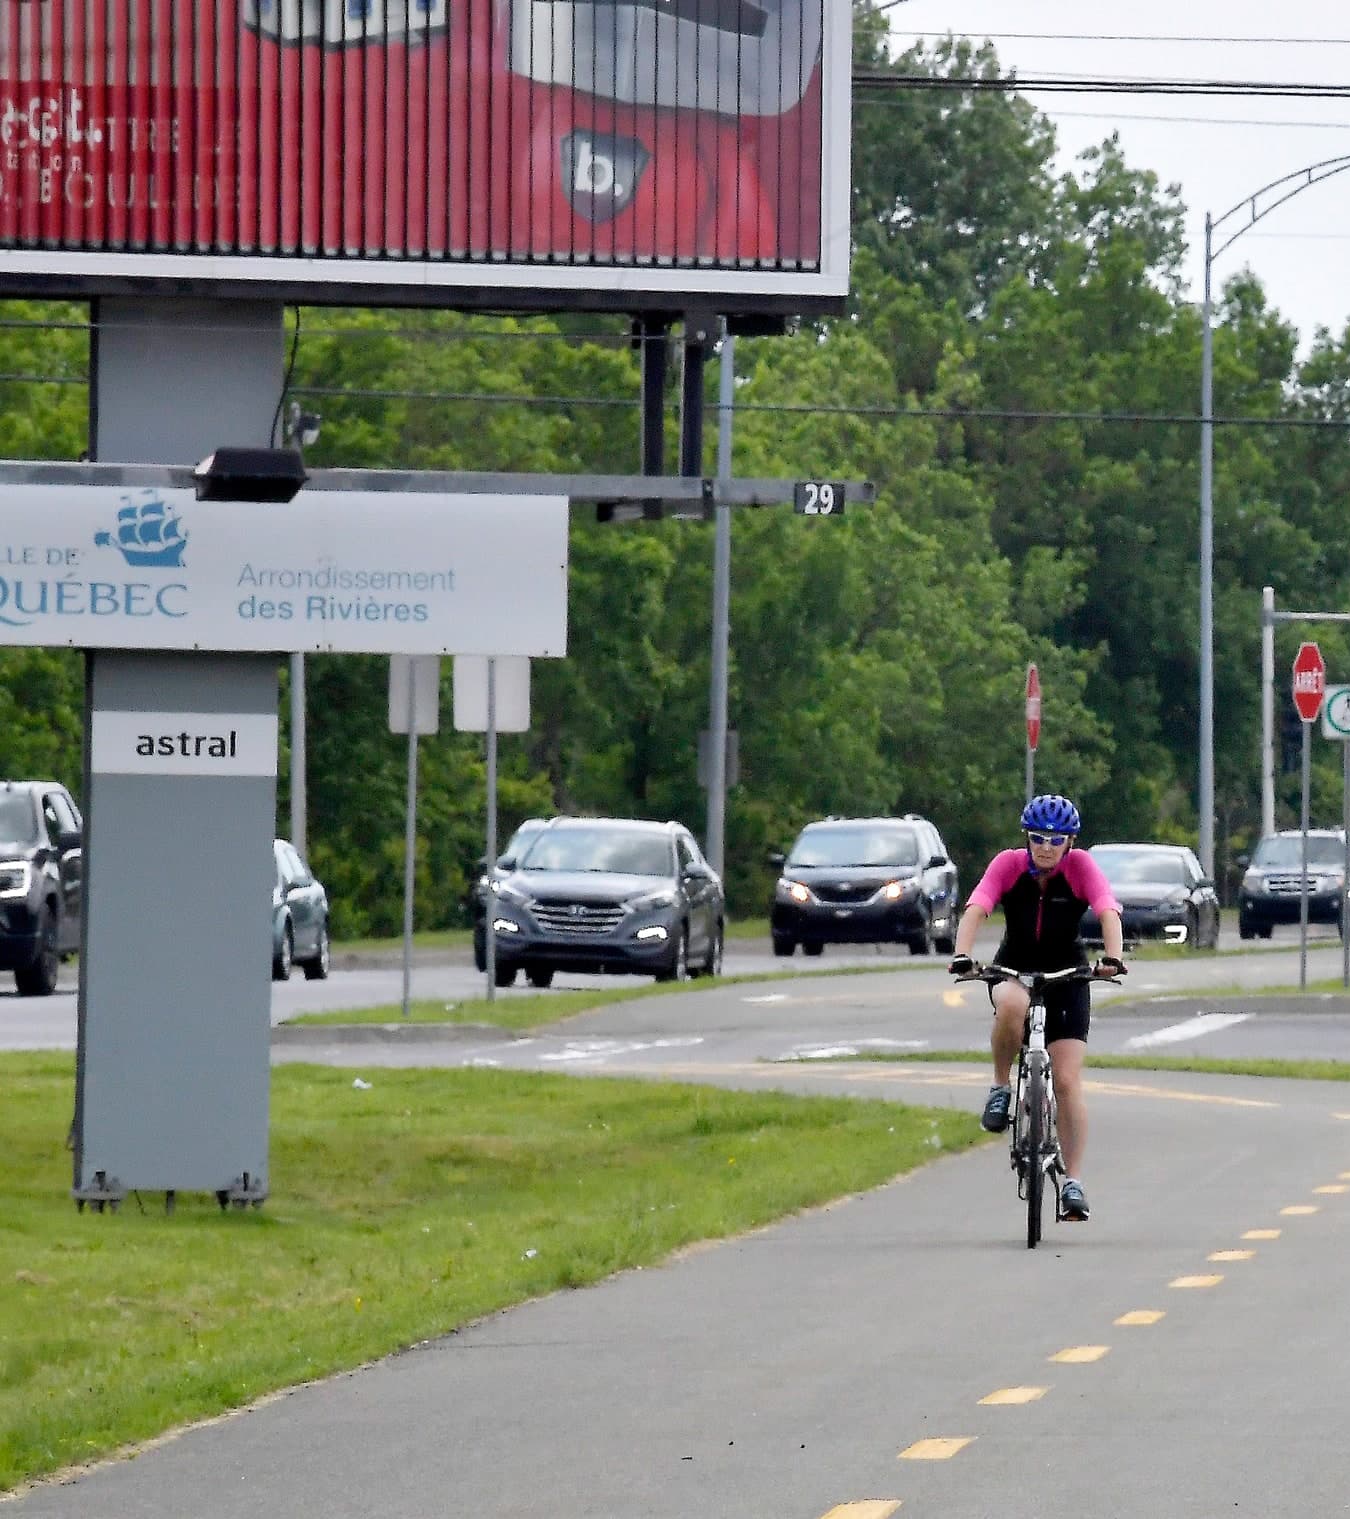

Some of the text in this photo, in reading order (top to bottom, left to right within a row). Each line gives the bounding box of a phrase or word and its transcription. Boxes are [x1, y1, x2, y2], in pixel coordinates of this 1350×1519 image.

[804, 483, 835, 515] 29
[46, 548, 79, 566] DE
[236, 562, 456, 592] Arrondissement
[237, 595, 430, 622] des Rivières
[135, 730, 237, 758] astral
